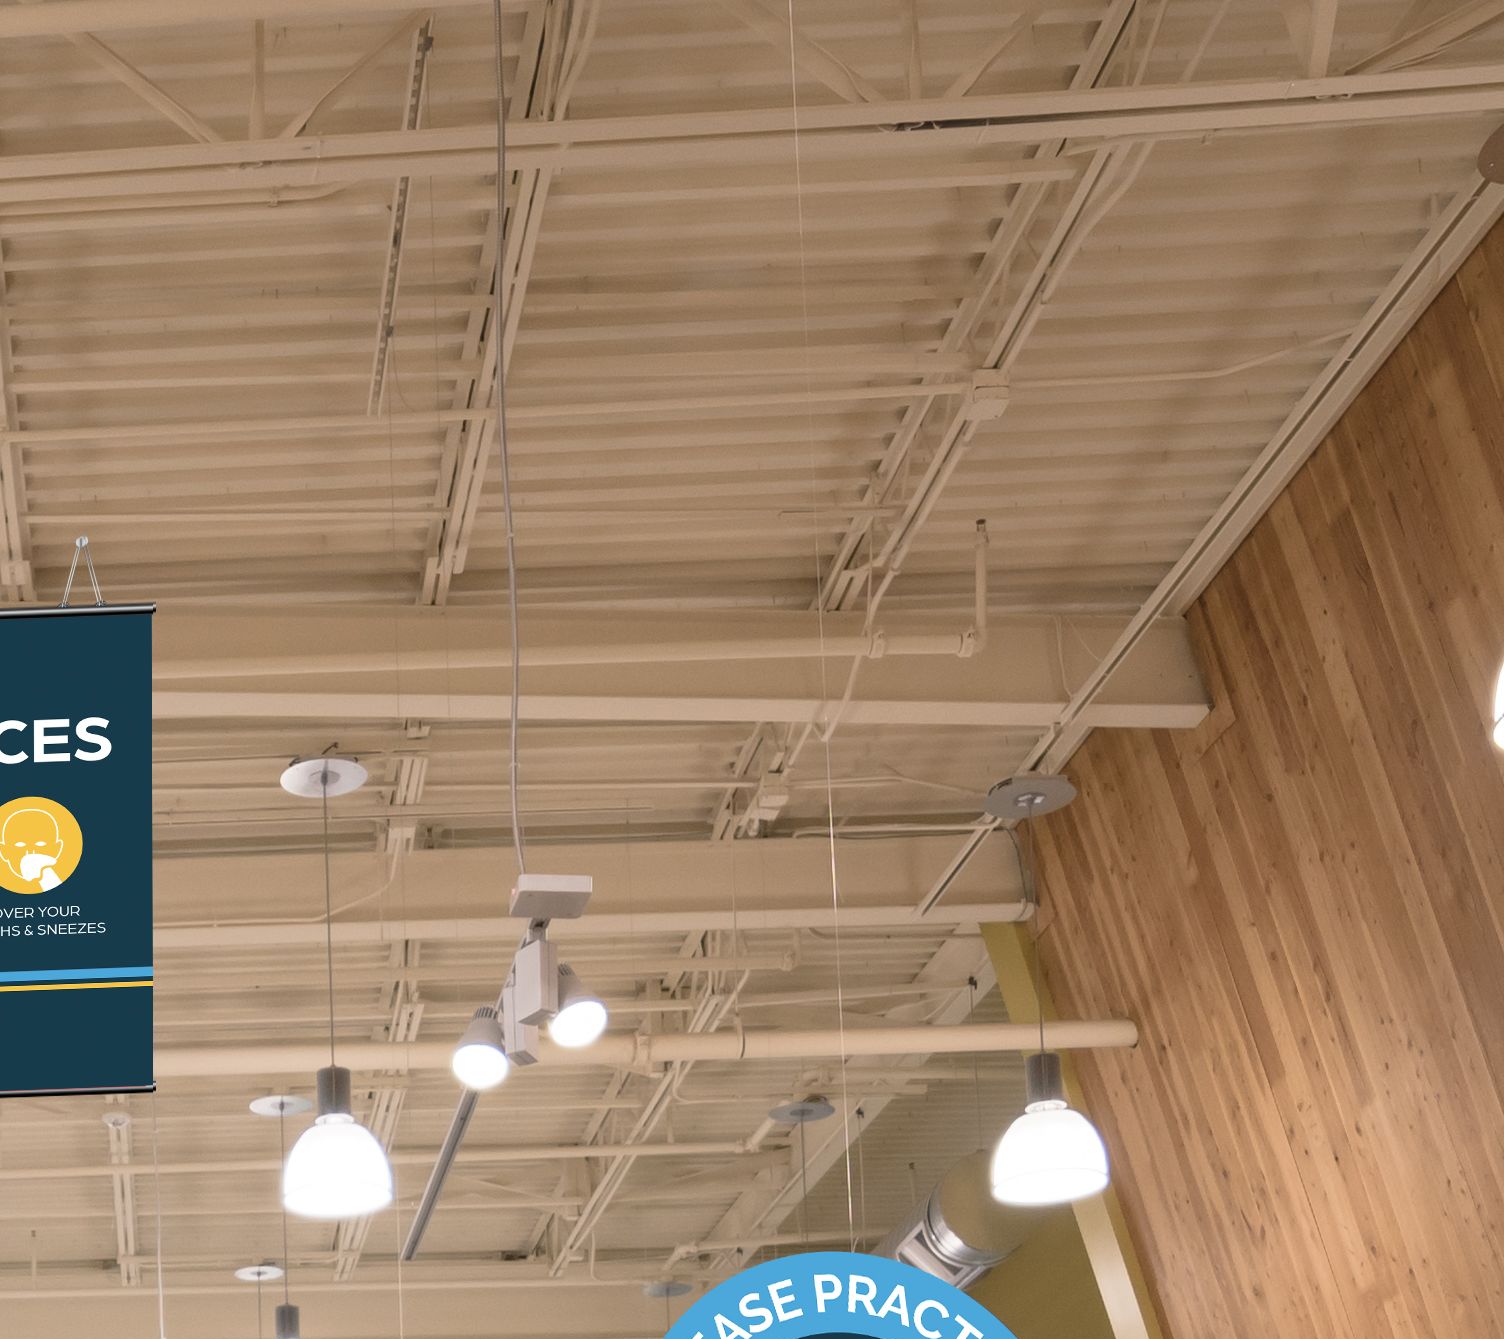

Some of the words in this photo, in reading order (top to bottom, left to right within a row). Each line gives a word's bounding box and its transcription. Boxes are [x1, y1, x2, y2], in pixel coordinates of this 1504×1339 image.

[37, 905, 81, 918] YOUR
[24, 924, 34, 936] &
[37, 921, 107, 936] SNEEZES
